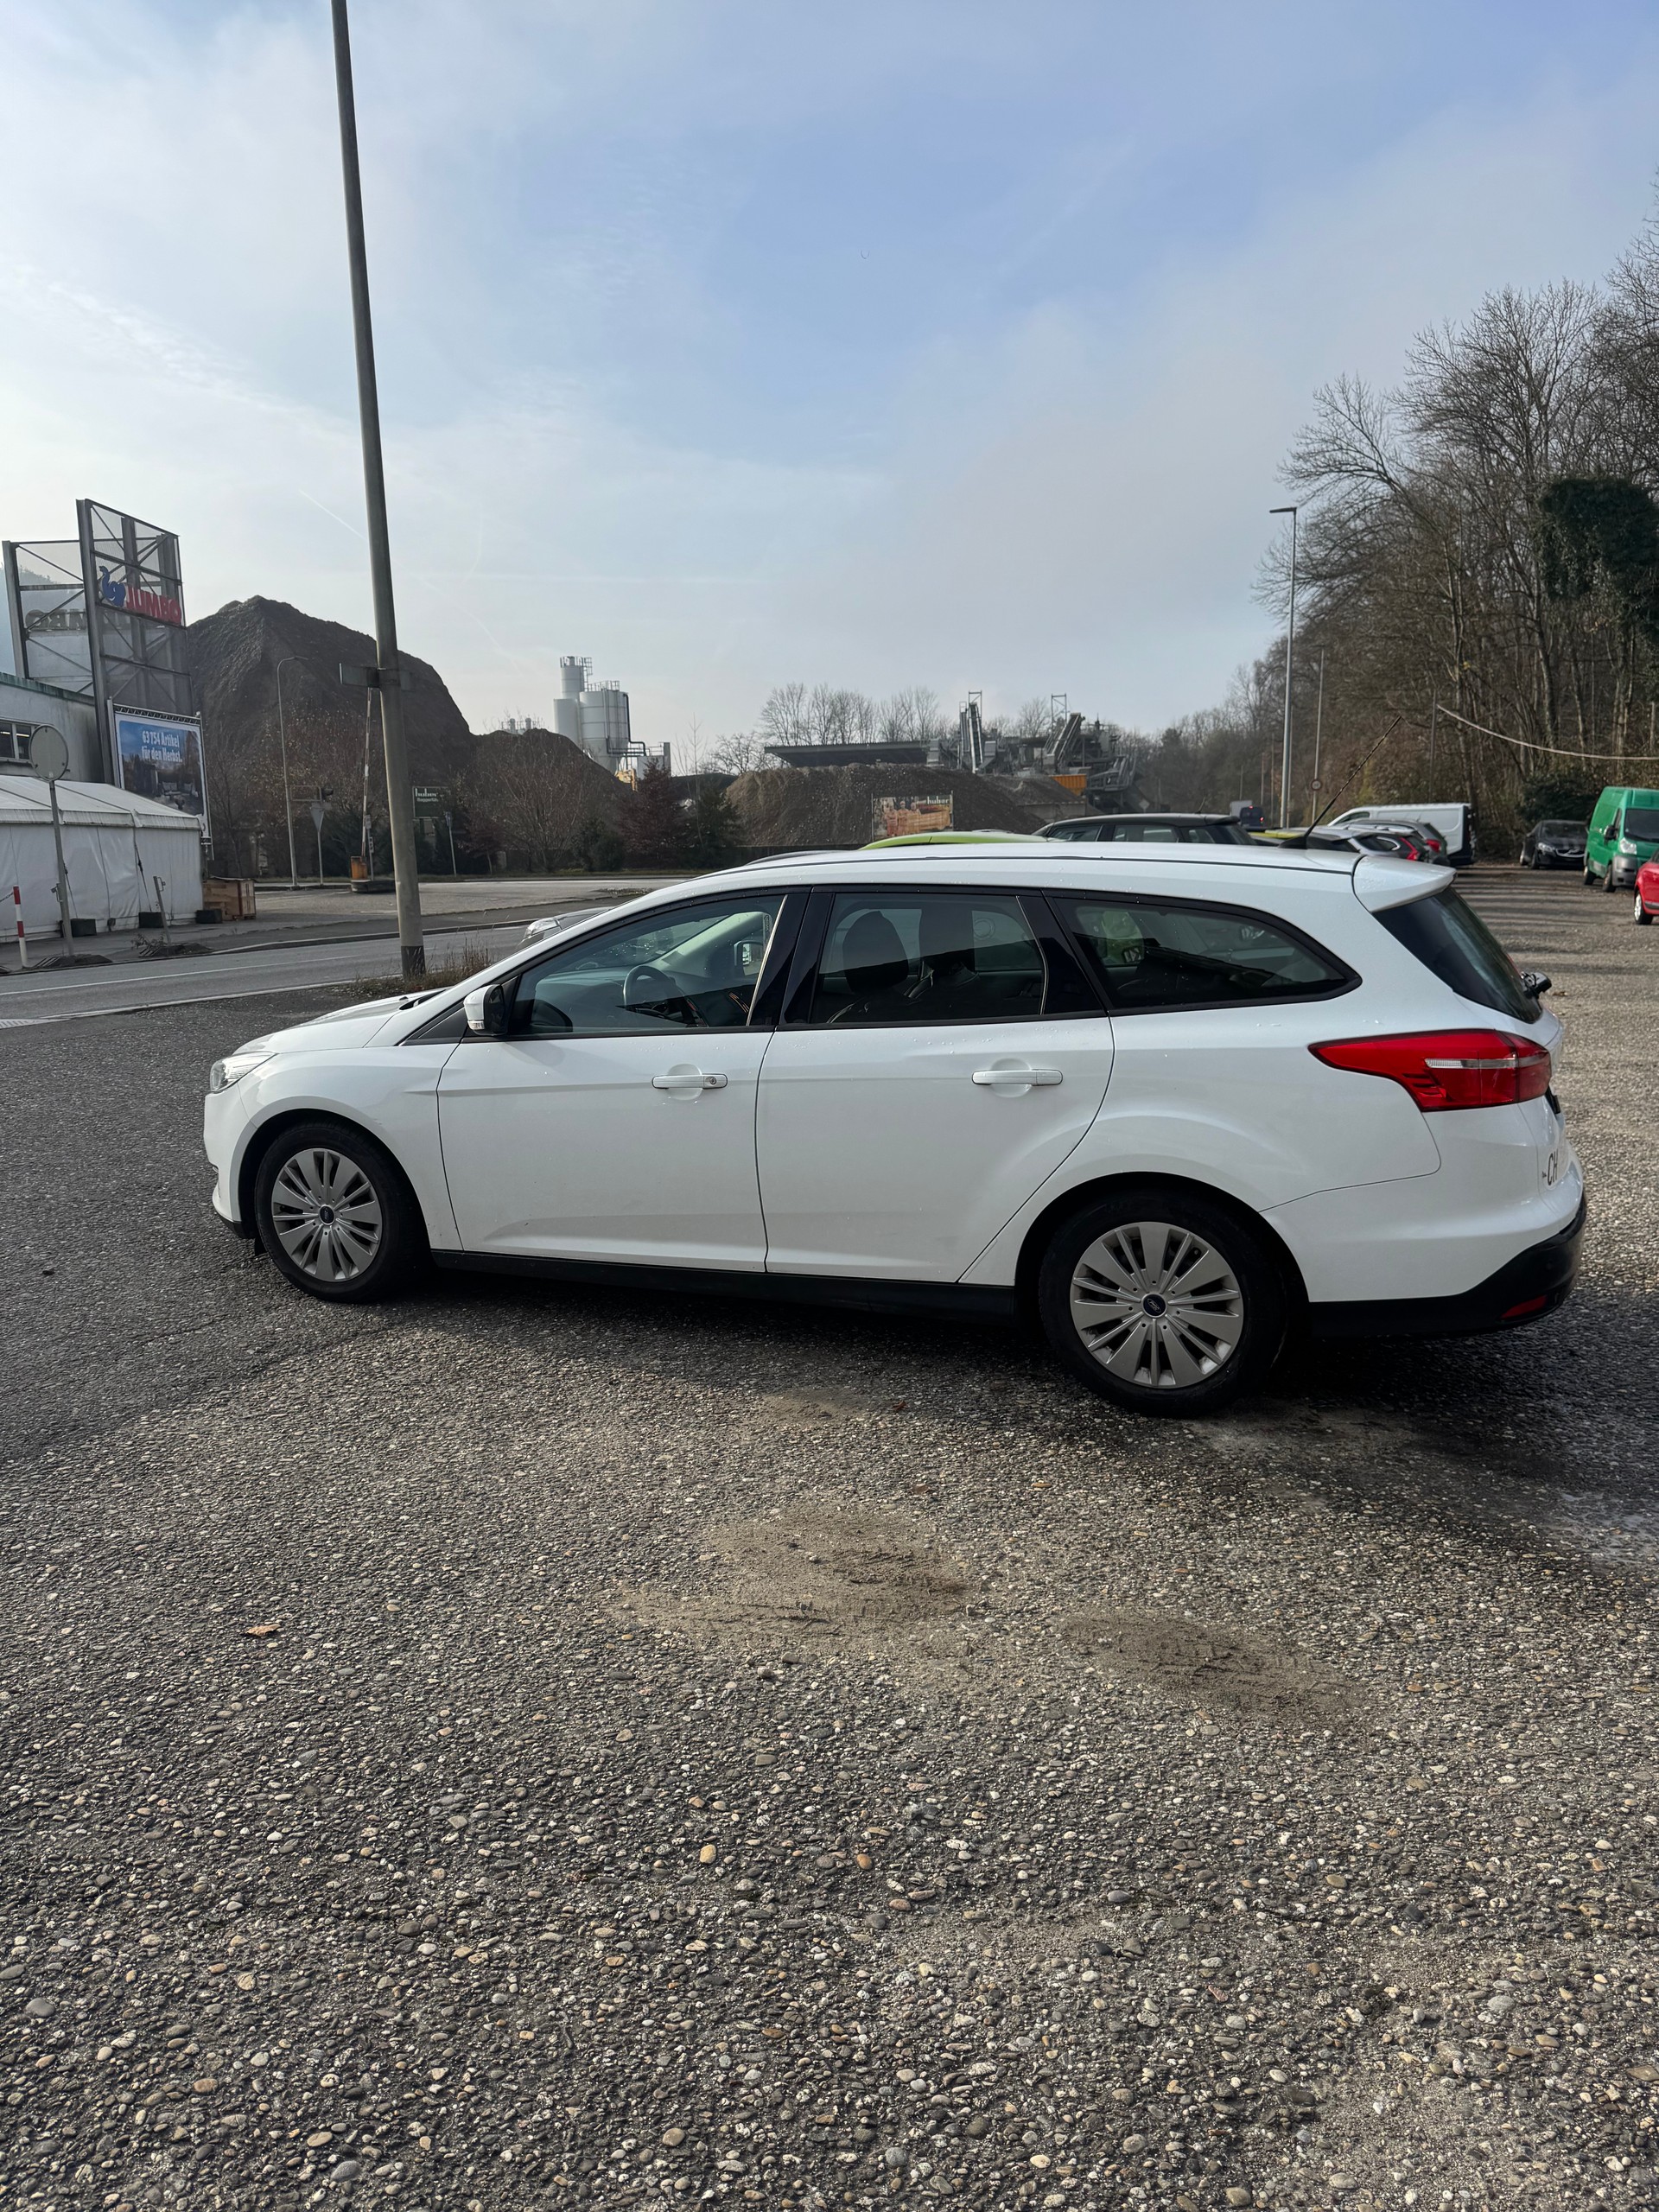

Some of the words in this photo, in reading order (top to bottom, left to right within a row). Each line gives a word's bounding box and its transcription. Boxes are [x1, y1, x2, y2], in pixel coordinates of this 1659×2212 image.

[125, 585, 182, 624] JUMBO
[162, 732, 180, 747] Artikel
[142, 745, 150, 760] für
[151, 747, 162, 760] den
[927, 796, 949, 804] huber
